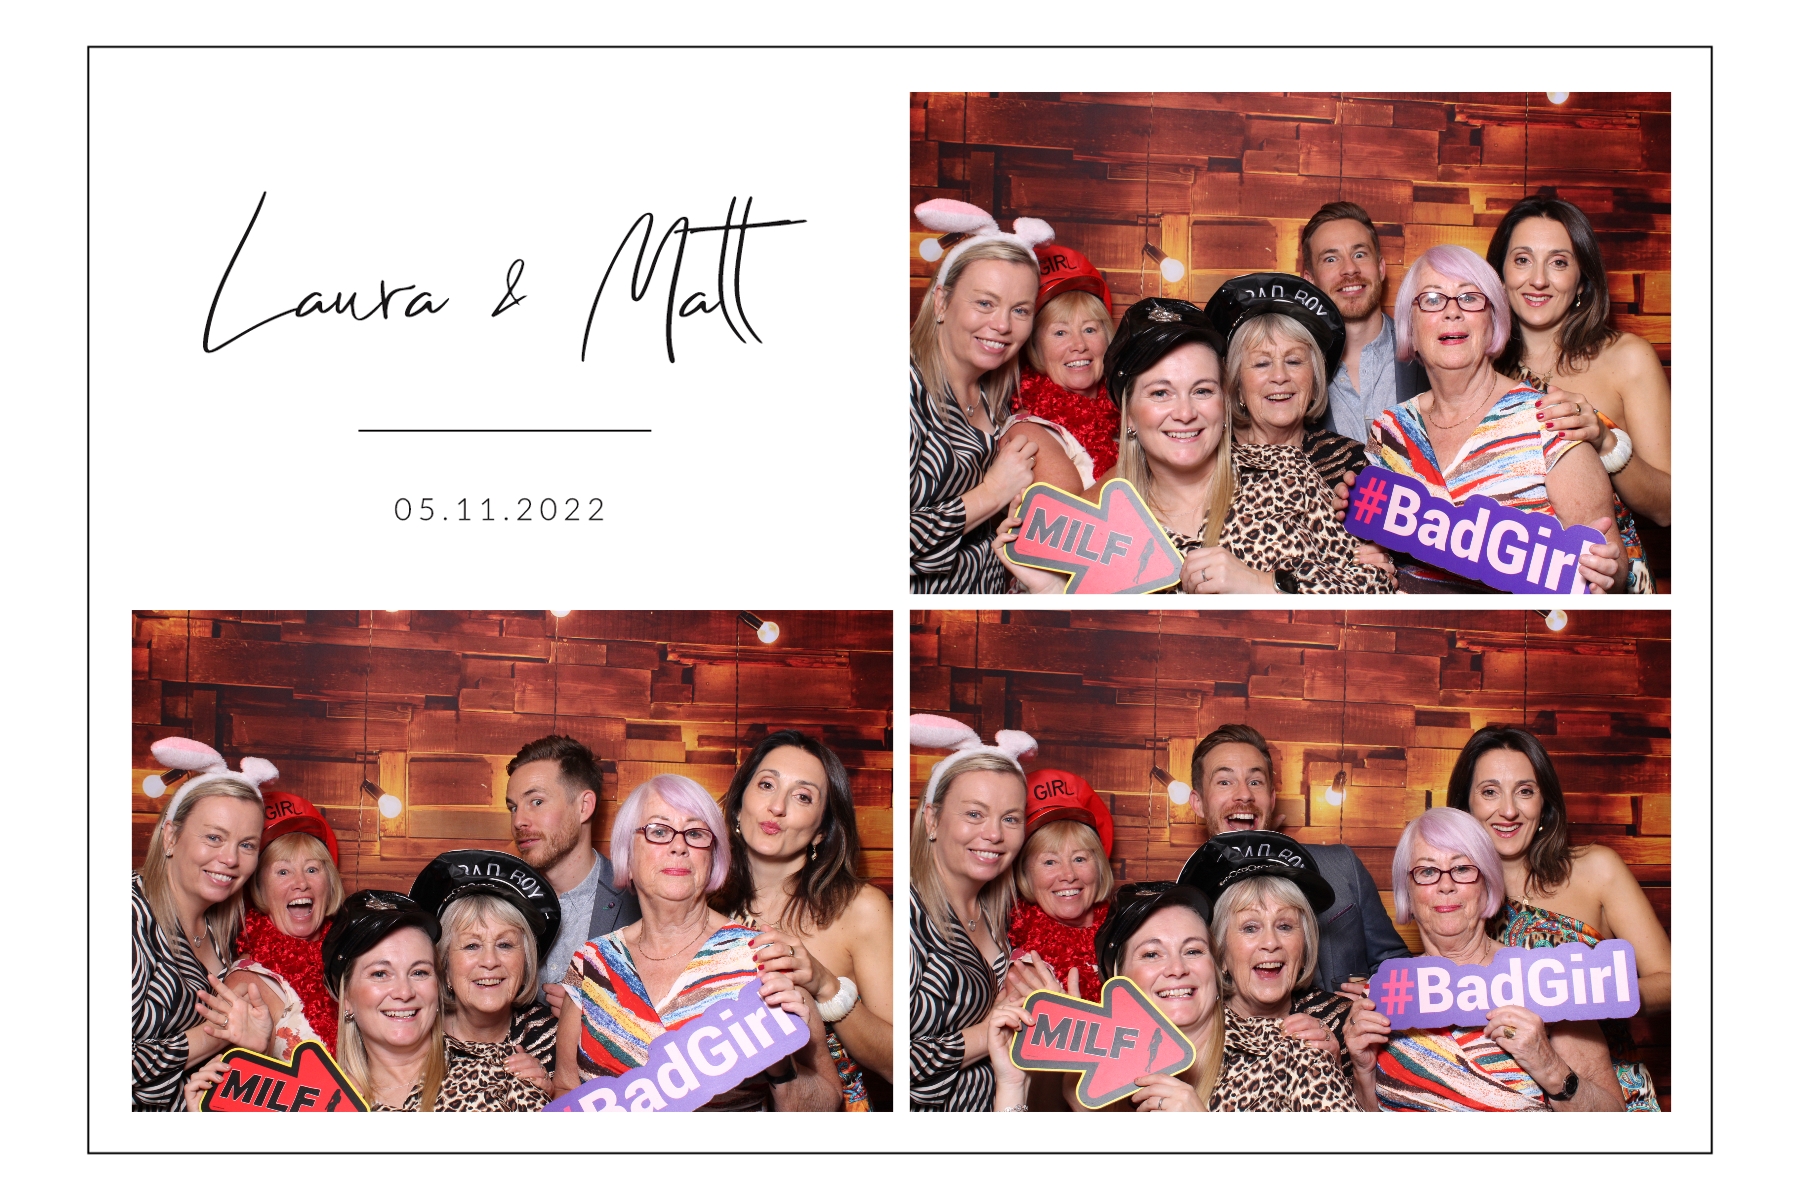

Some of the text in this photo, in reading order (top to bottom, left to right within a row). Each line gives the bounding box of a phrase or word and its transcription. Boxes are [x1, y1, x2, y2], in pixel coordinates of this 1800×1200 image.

[1040, 254, 1077, 276] GIRL
[1025, 507, 1133, 566] MILF
[264, 800, 303, 820] GIRL
[1033, 779, 1075, 801] GIRL
[1381, 950, 1631, 1016] #BadGirl
[1030, 1012, 1140, 1060] MILF
[219, 1068, 322, 1112] MILF
